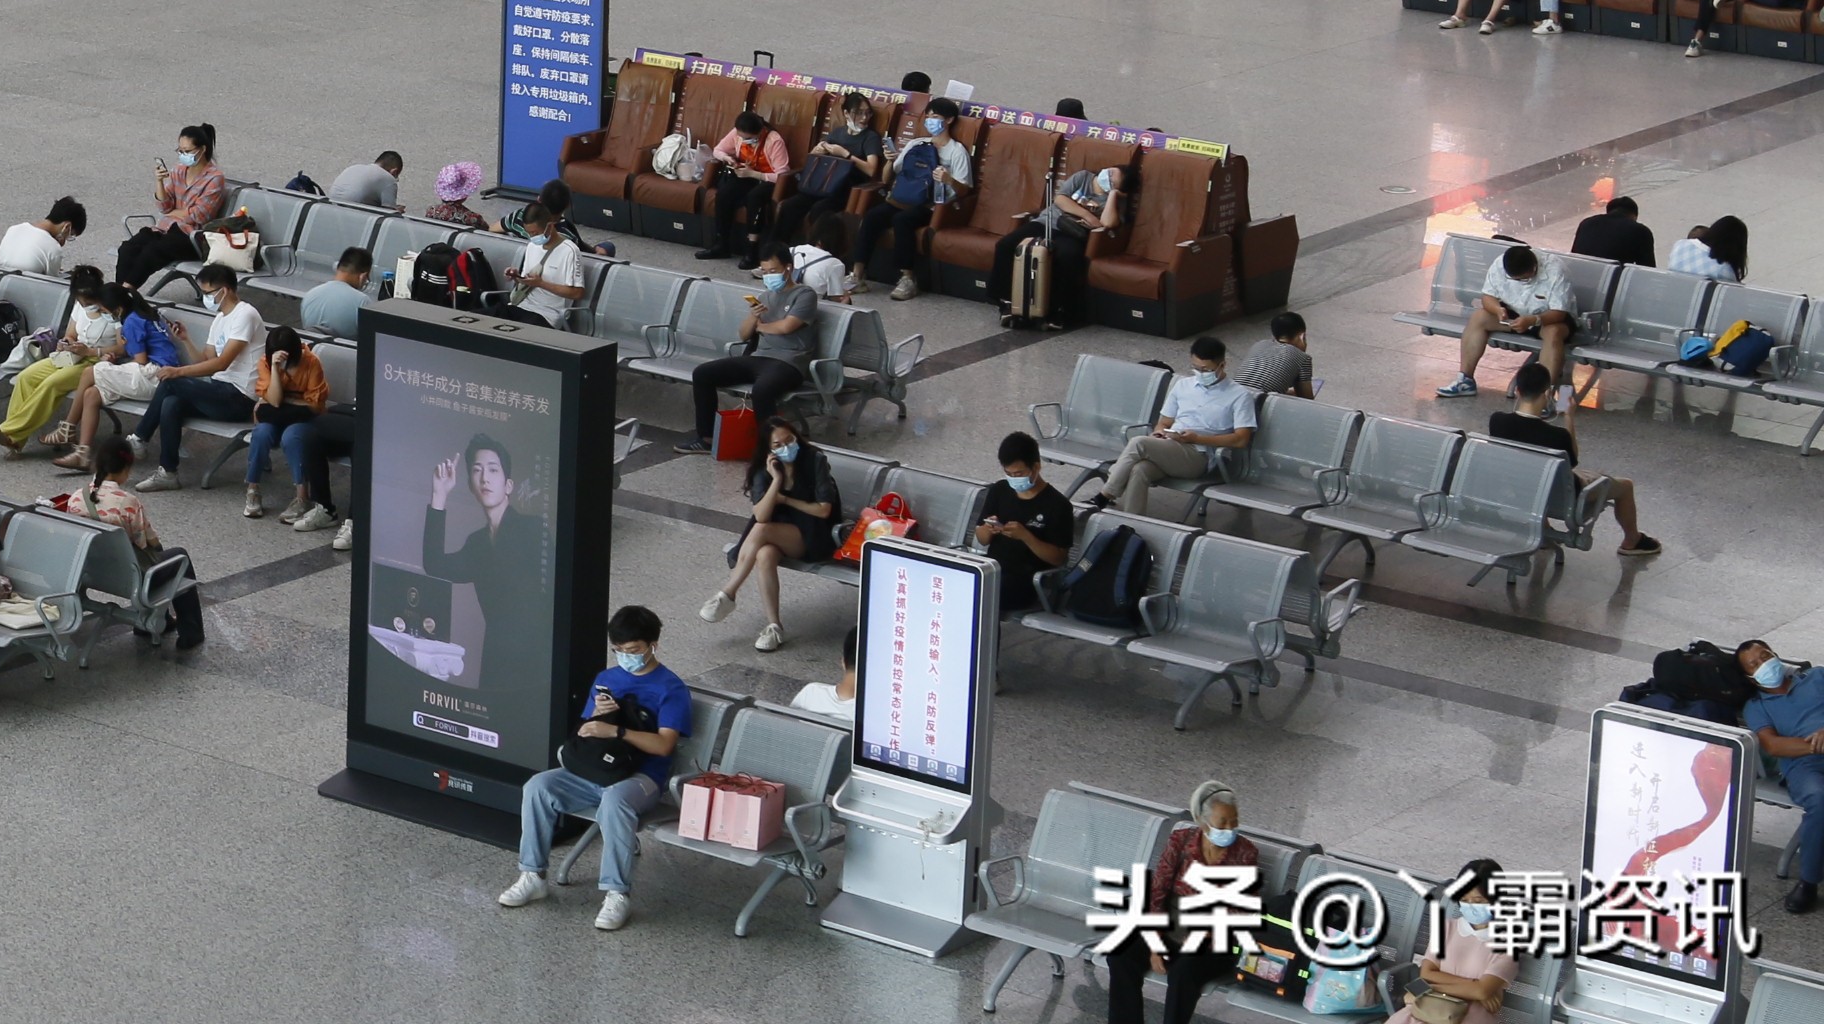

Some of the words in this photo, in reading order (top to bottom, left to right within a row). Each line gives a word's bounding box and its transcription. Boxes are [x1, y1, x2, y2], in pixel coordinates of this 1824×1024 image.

[691, 60, 723, 76] 扫码
[731, 64, 753, 75] 按摩
[767, 75, 781, 85] 比
[791, 74, 813, 85] 共享
[825, 82, 907, 104] 更快更方便
[384, 363, 462, 395] 8大精华成分
[465, 381, 550, 416] 密集滋养秀发
[889, 568, 908, 751] 认真抓好疫情防控常态化工作
[423, 690, 460, 712] FORVIL
[435, 720, 458, 733] FORVIL
[1627, 741, 1647, 847] 进入新时代
